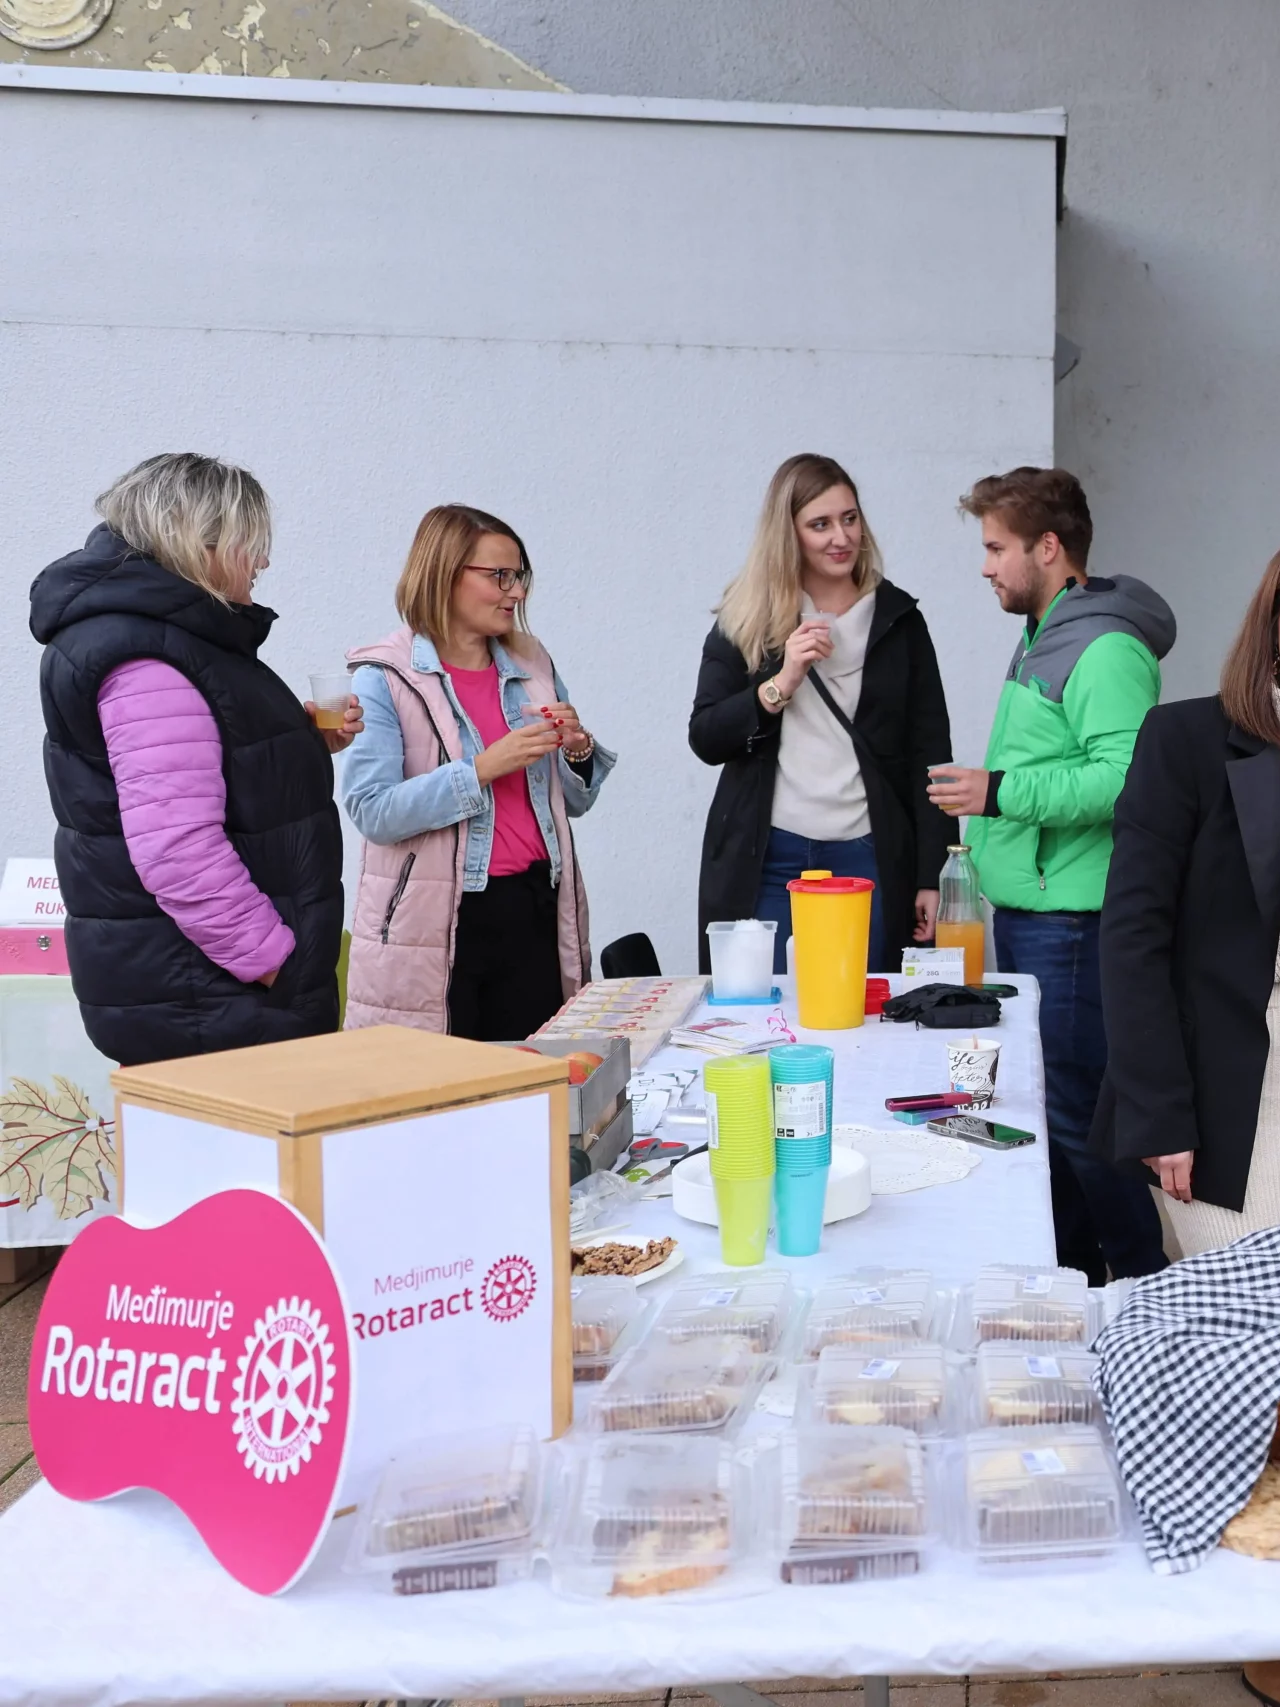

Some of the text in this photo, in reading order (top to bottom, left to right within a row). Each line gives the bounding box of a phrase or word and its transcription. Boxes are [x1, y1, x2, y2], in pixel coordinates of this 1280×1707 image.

[373, 1255, 475, 1297] Medjimurje
[105, 1284, 235, 1339] Međimurje
[268, 1317, 314, 1340] ROTARY
[352, 1287, 474, 1340] Rotaract
[40, 1324, 227, 1414] Rotaract
